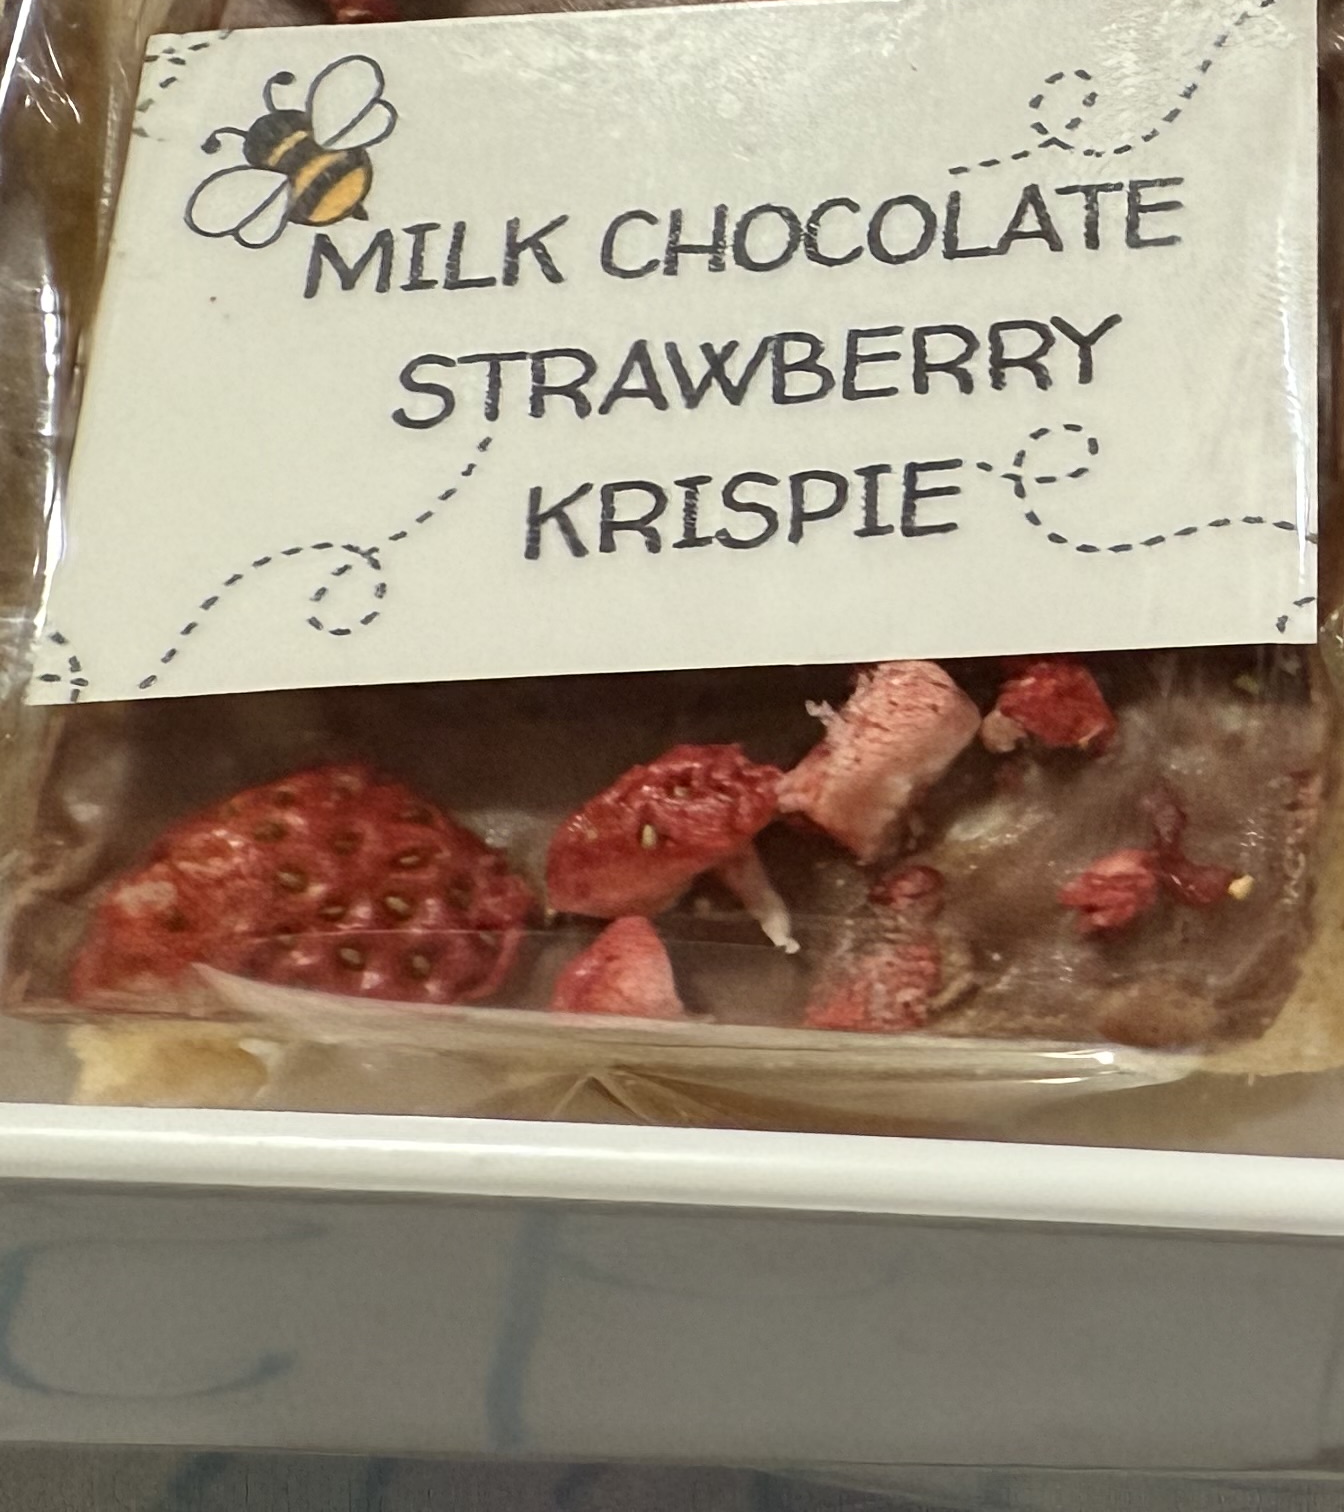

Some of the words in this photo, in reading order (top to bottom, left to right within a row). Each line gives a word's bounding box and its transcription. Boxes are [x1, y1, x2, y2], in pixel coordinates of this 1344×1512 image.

[303, 214, 569, 300] MILK
[600, 176, 1185, 279] CHOCOLATE
[391, 313, 1123, 430] STRAWBERRY
[523, 458, 964, 561] KRISPIE
